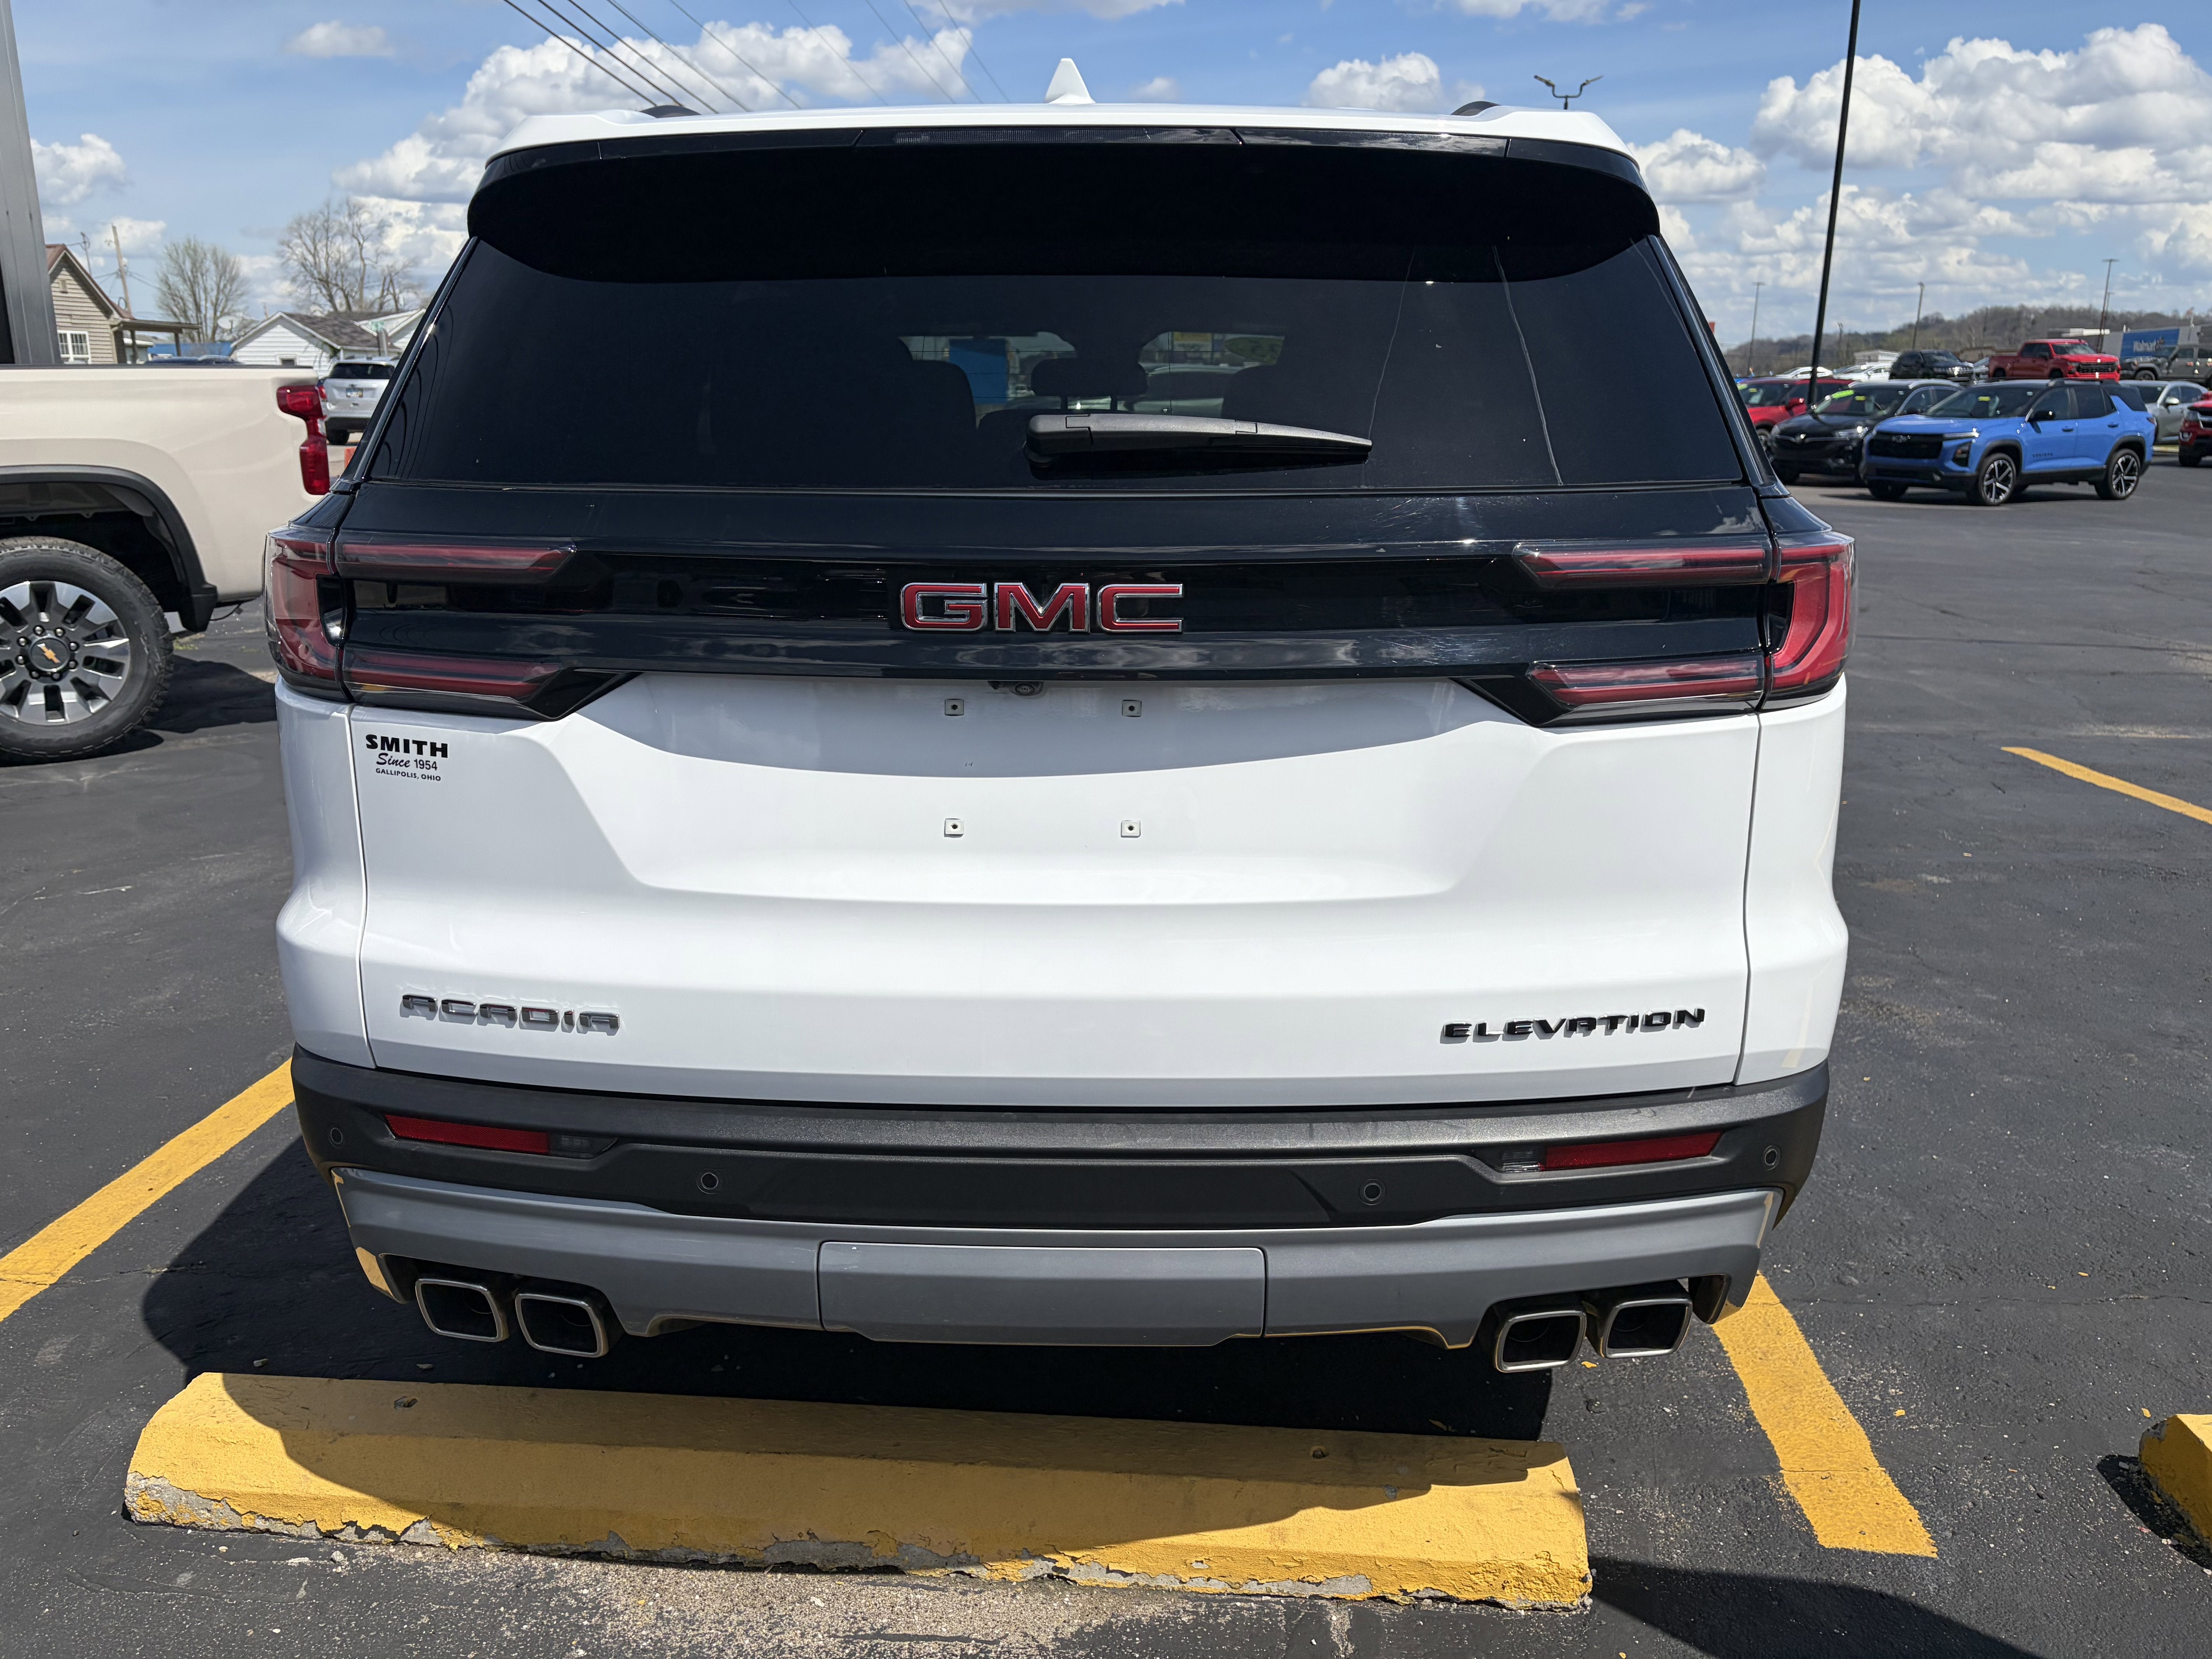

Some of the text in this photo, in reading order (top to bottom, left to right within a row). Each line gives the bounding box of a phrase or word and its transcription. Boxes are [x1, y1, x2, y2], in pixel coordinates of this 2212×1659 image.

[901, 582, 1184, 633] GMC
[366, 734, 448, 758] SMITH
[376, 753, 438, 771] Since 1954
[376, 768, 419, 780] GALLIPOLIS,
[402, 994, 620, 1029] ACADIA
[1444, 1008, 1705, 1037] ELEVATION
